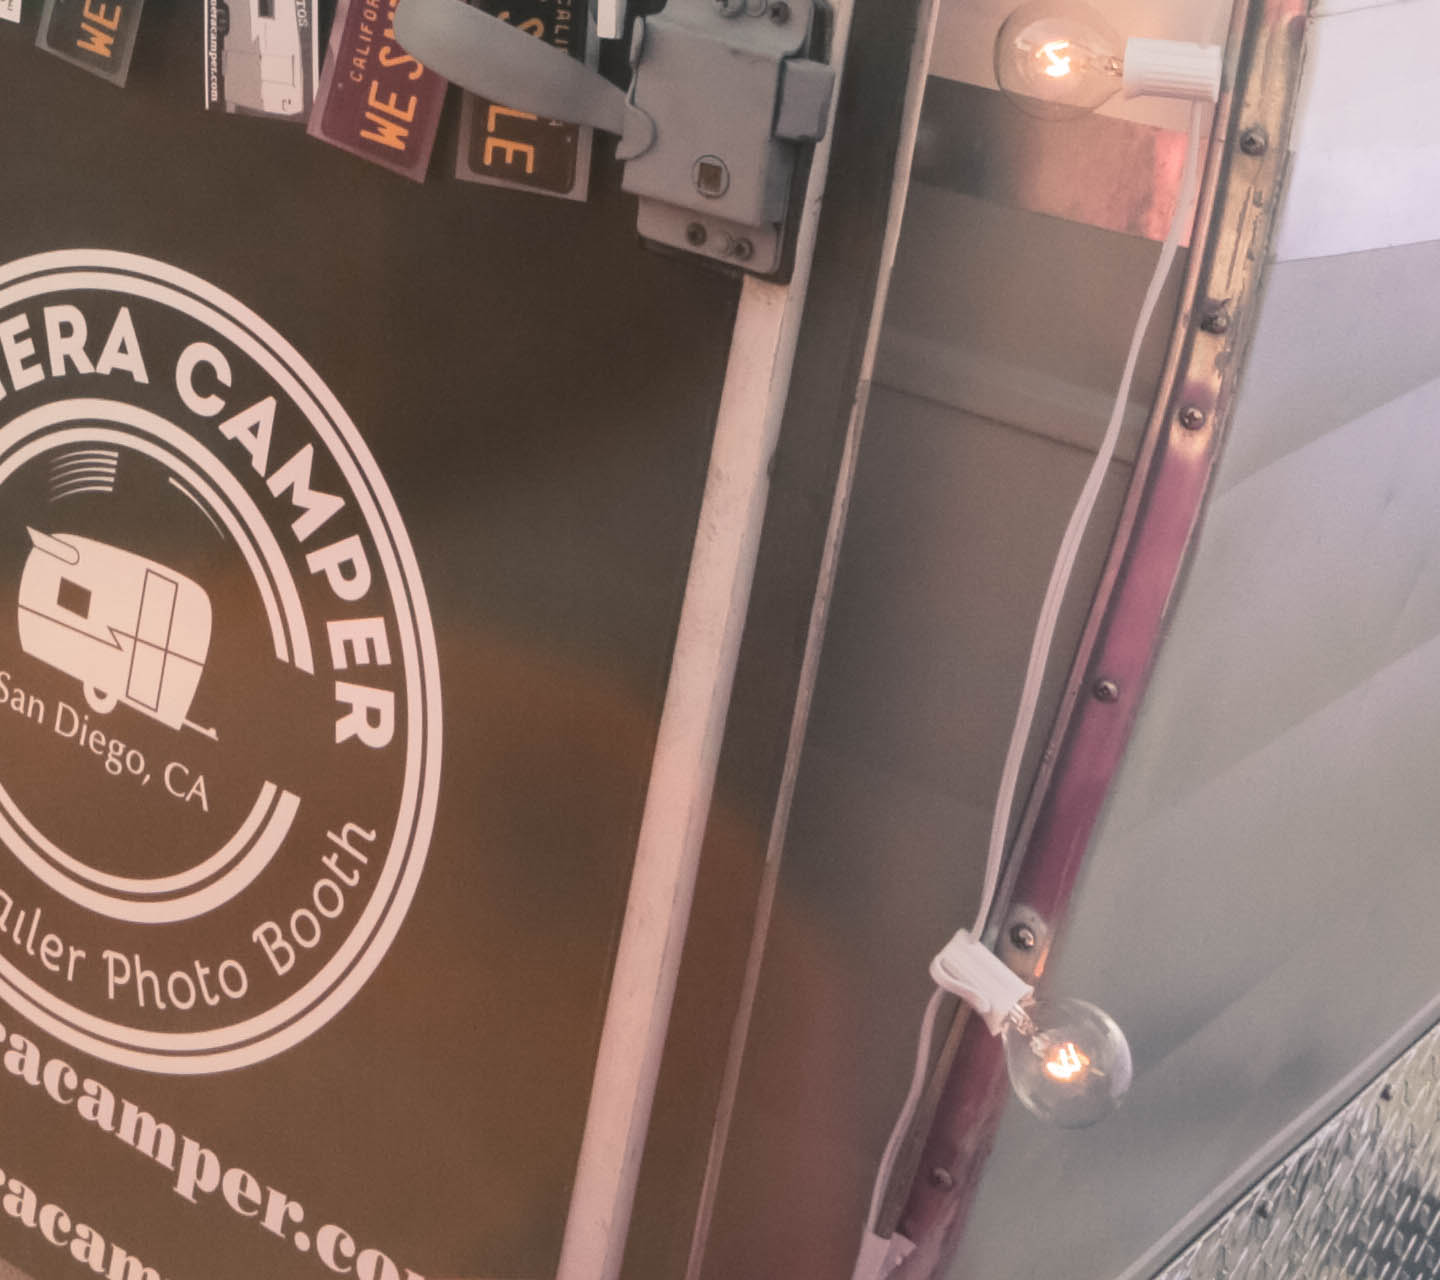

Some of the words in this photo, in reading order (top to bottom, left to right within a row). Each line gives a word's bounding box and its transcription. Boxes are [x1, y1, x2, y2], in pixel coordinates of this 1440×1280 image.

[360, 80, 417, 151] WE
[174, 341, 397, 751] CAMPER
[54, 701, 151, 785] Diego,
[164, 762, 209, 812] CA
[102, 951, 249, 1011] Photo
[252, 820, 378, 978] Booth
